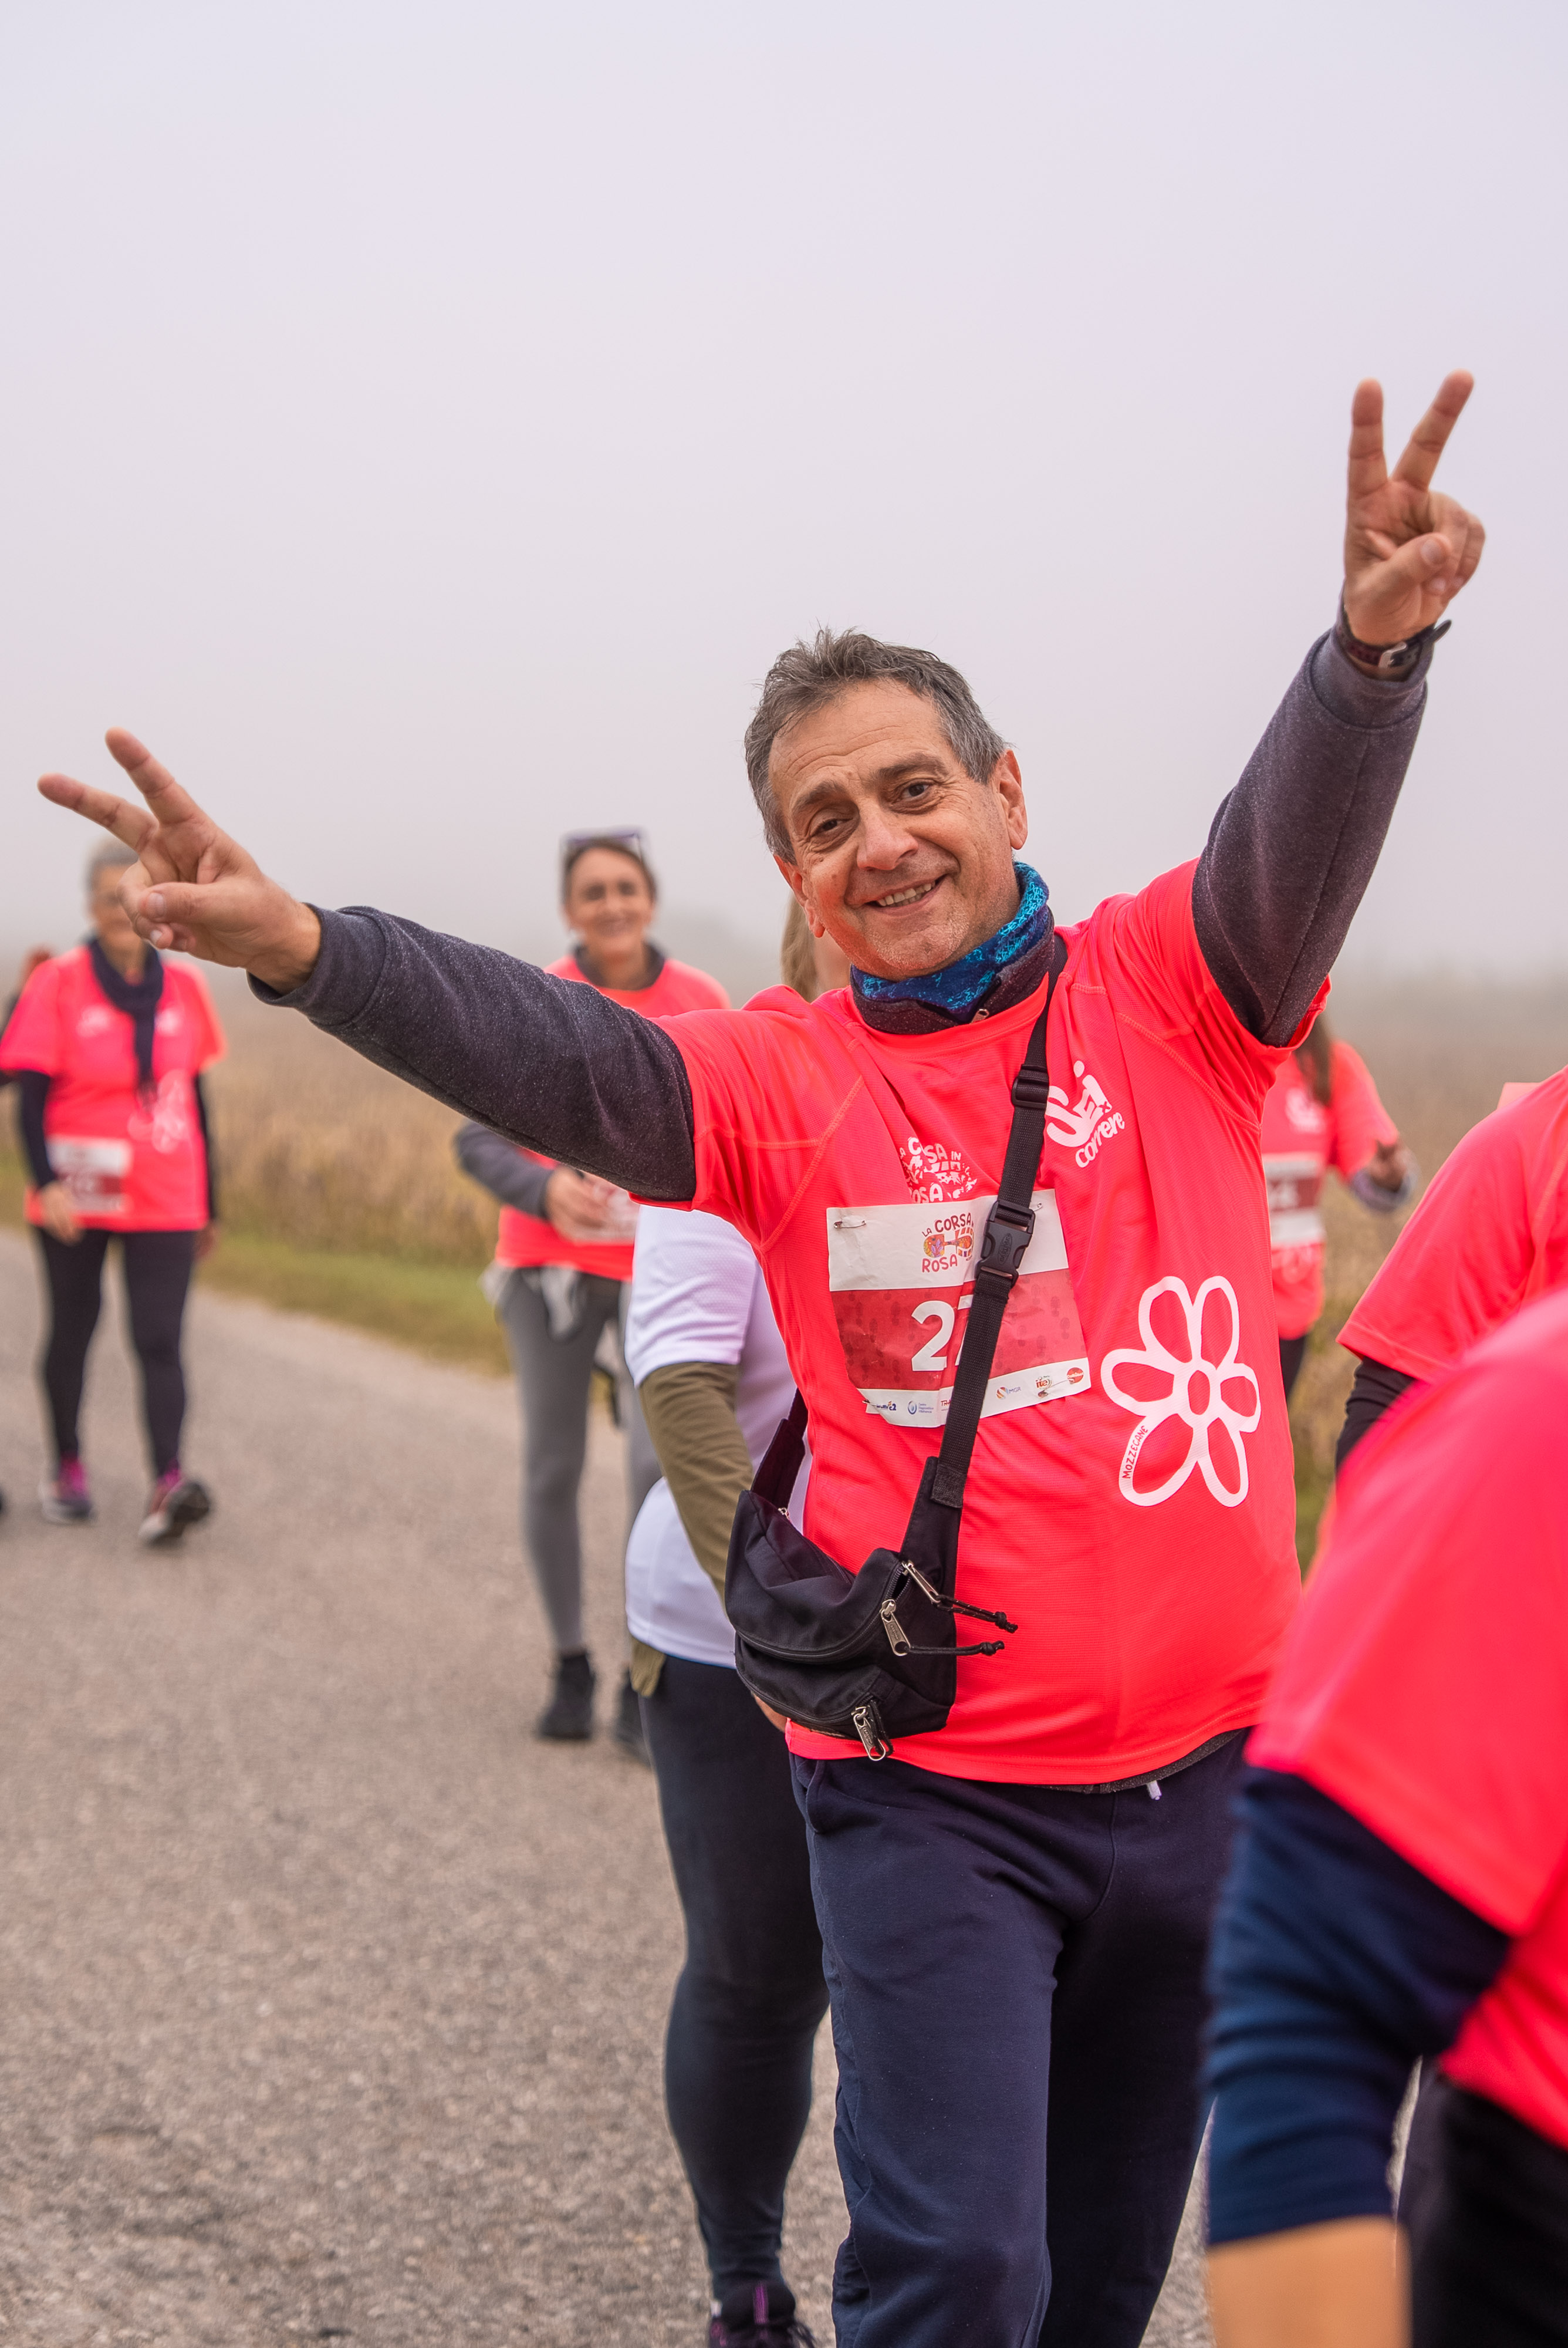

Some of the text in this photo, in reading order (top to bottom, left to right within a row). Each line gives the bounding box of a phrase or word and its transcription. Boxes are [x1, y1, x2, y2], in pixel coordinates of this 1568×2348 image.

[907, 1136, 948, 1164] CSA
[951, 1151, 962, 1161] IN
[910, 1182, 944, 1204] OSA
[921, 1227, 932, 1237] LA
[934, 1212, 972, 1233] CORSA
[921, 1254, 958, 1273] ROSA
[1121, 1425, 1148, 1479] MOZZECANE
